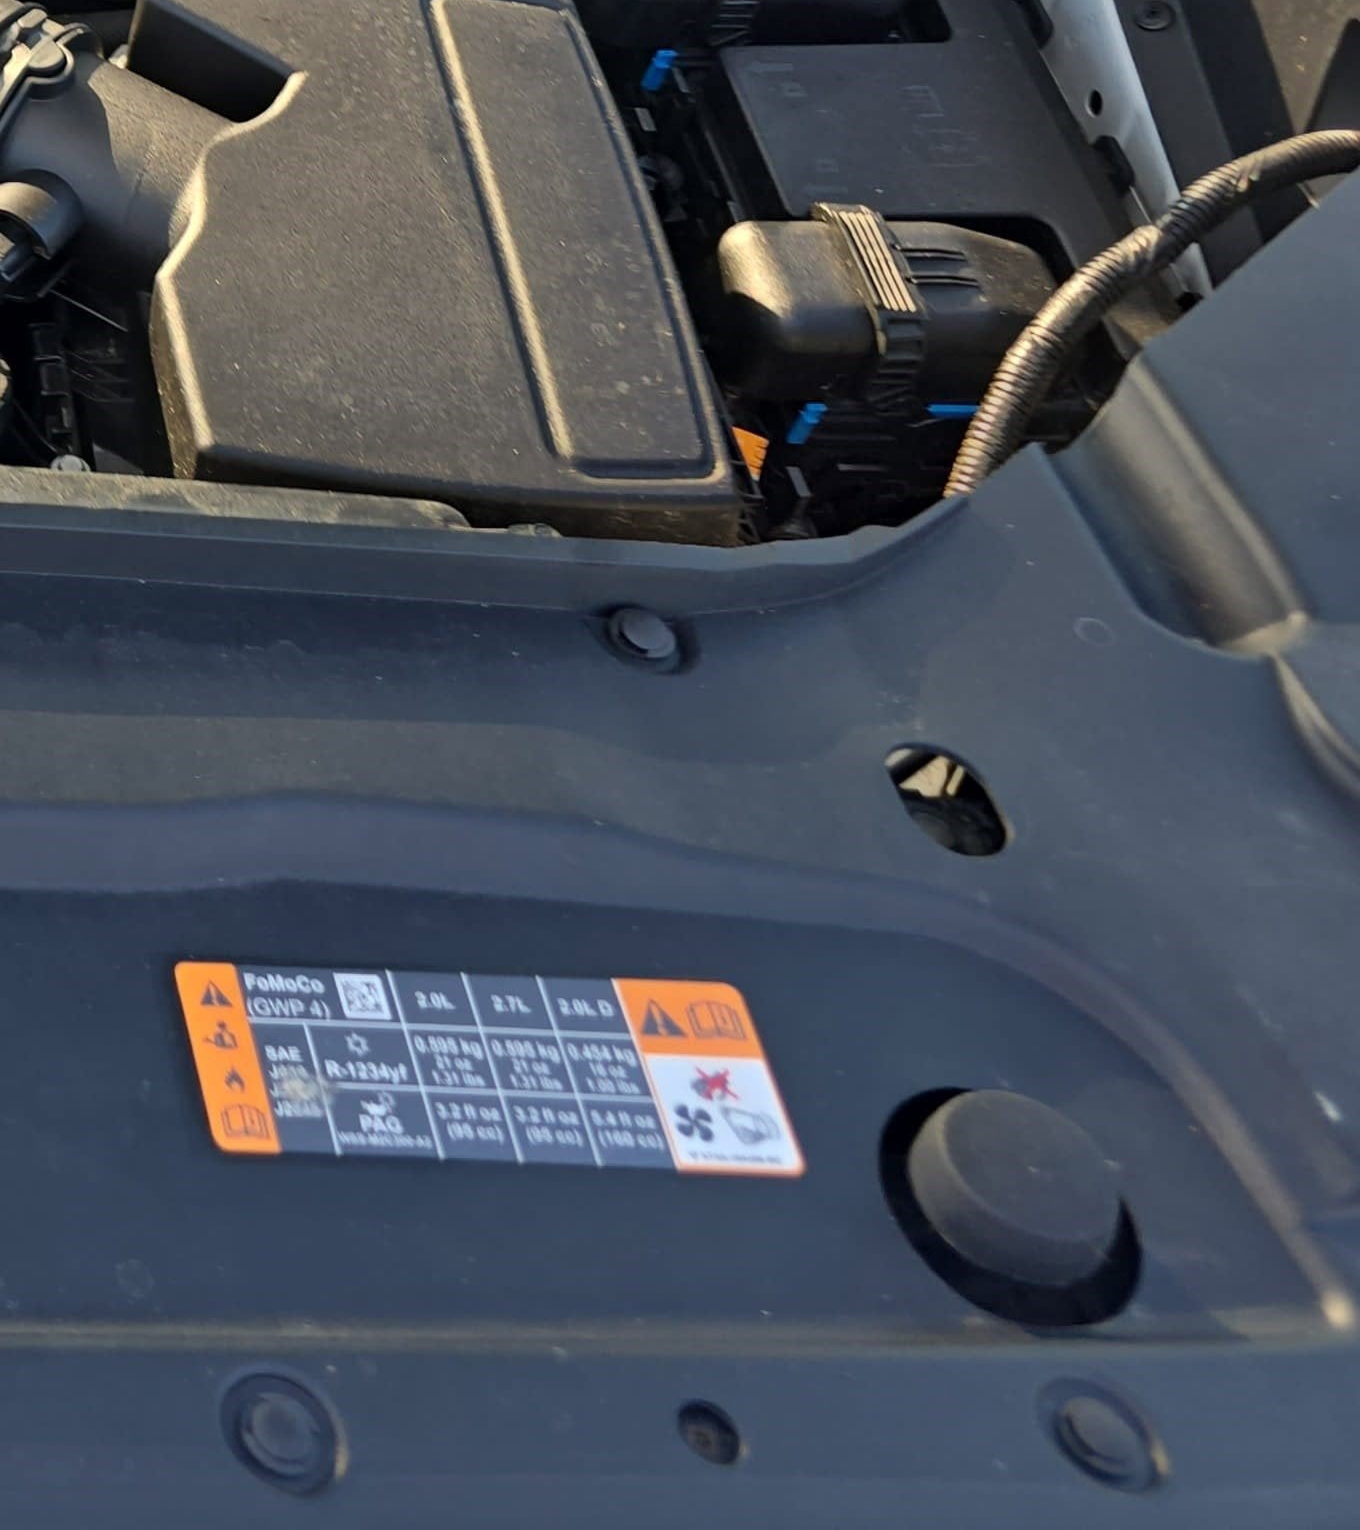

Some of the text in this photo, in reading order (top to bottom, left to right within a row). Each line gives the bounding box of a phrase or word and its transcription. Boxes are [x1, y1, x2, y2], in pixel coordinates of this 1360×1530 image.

[243, 972, 325, 994] FoMoCo
[247, 996, 332, 1020] (GWP 4)
[324, 1059, 408, 1084] R-1234yf
[359, 1114, 404, 1135] PAG
